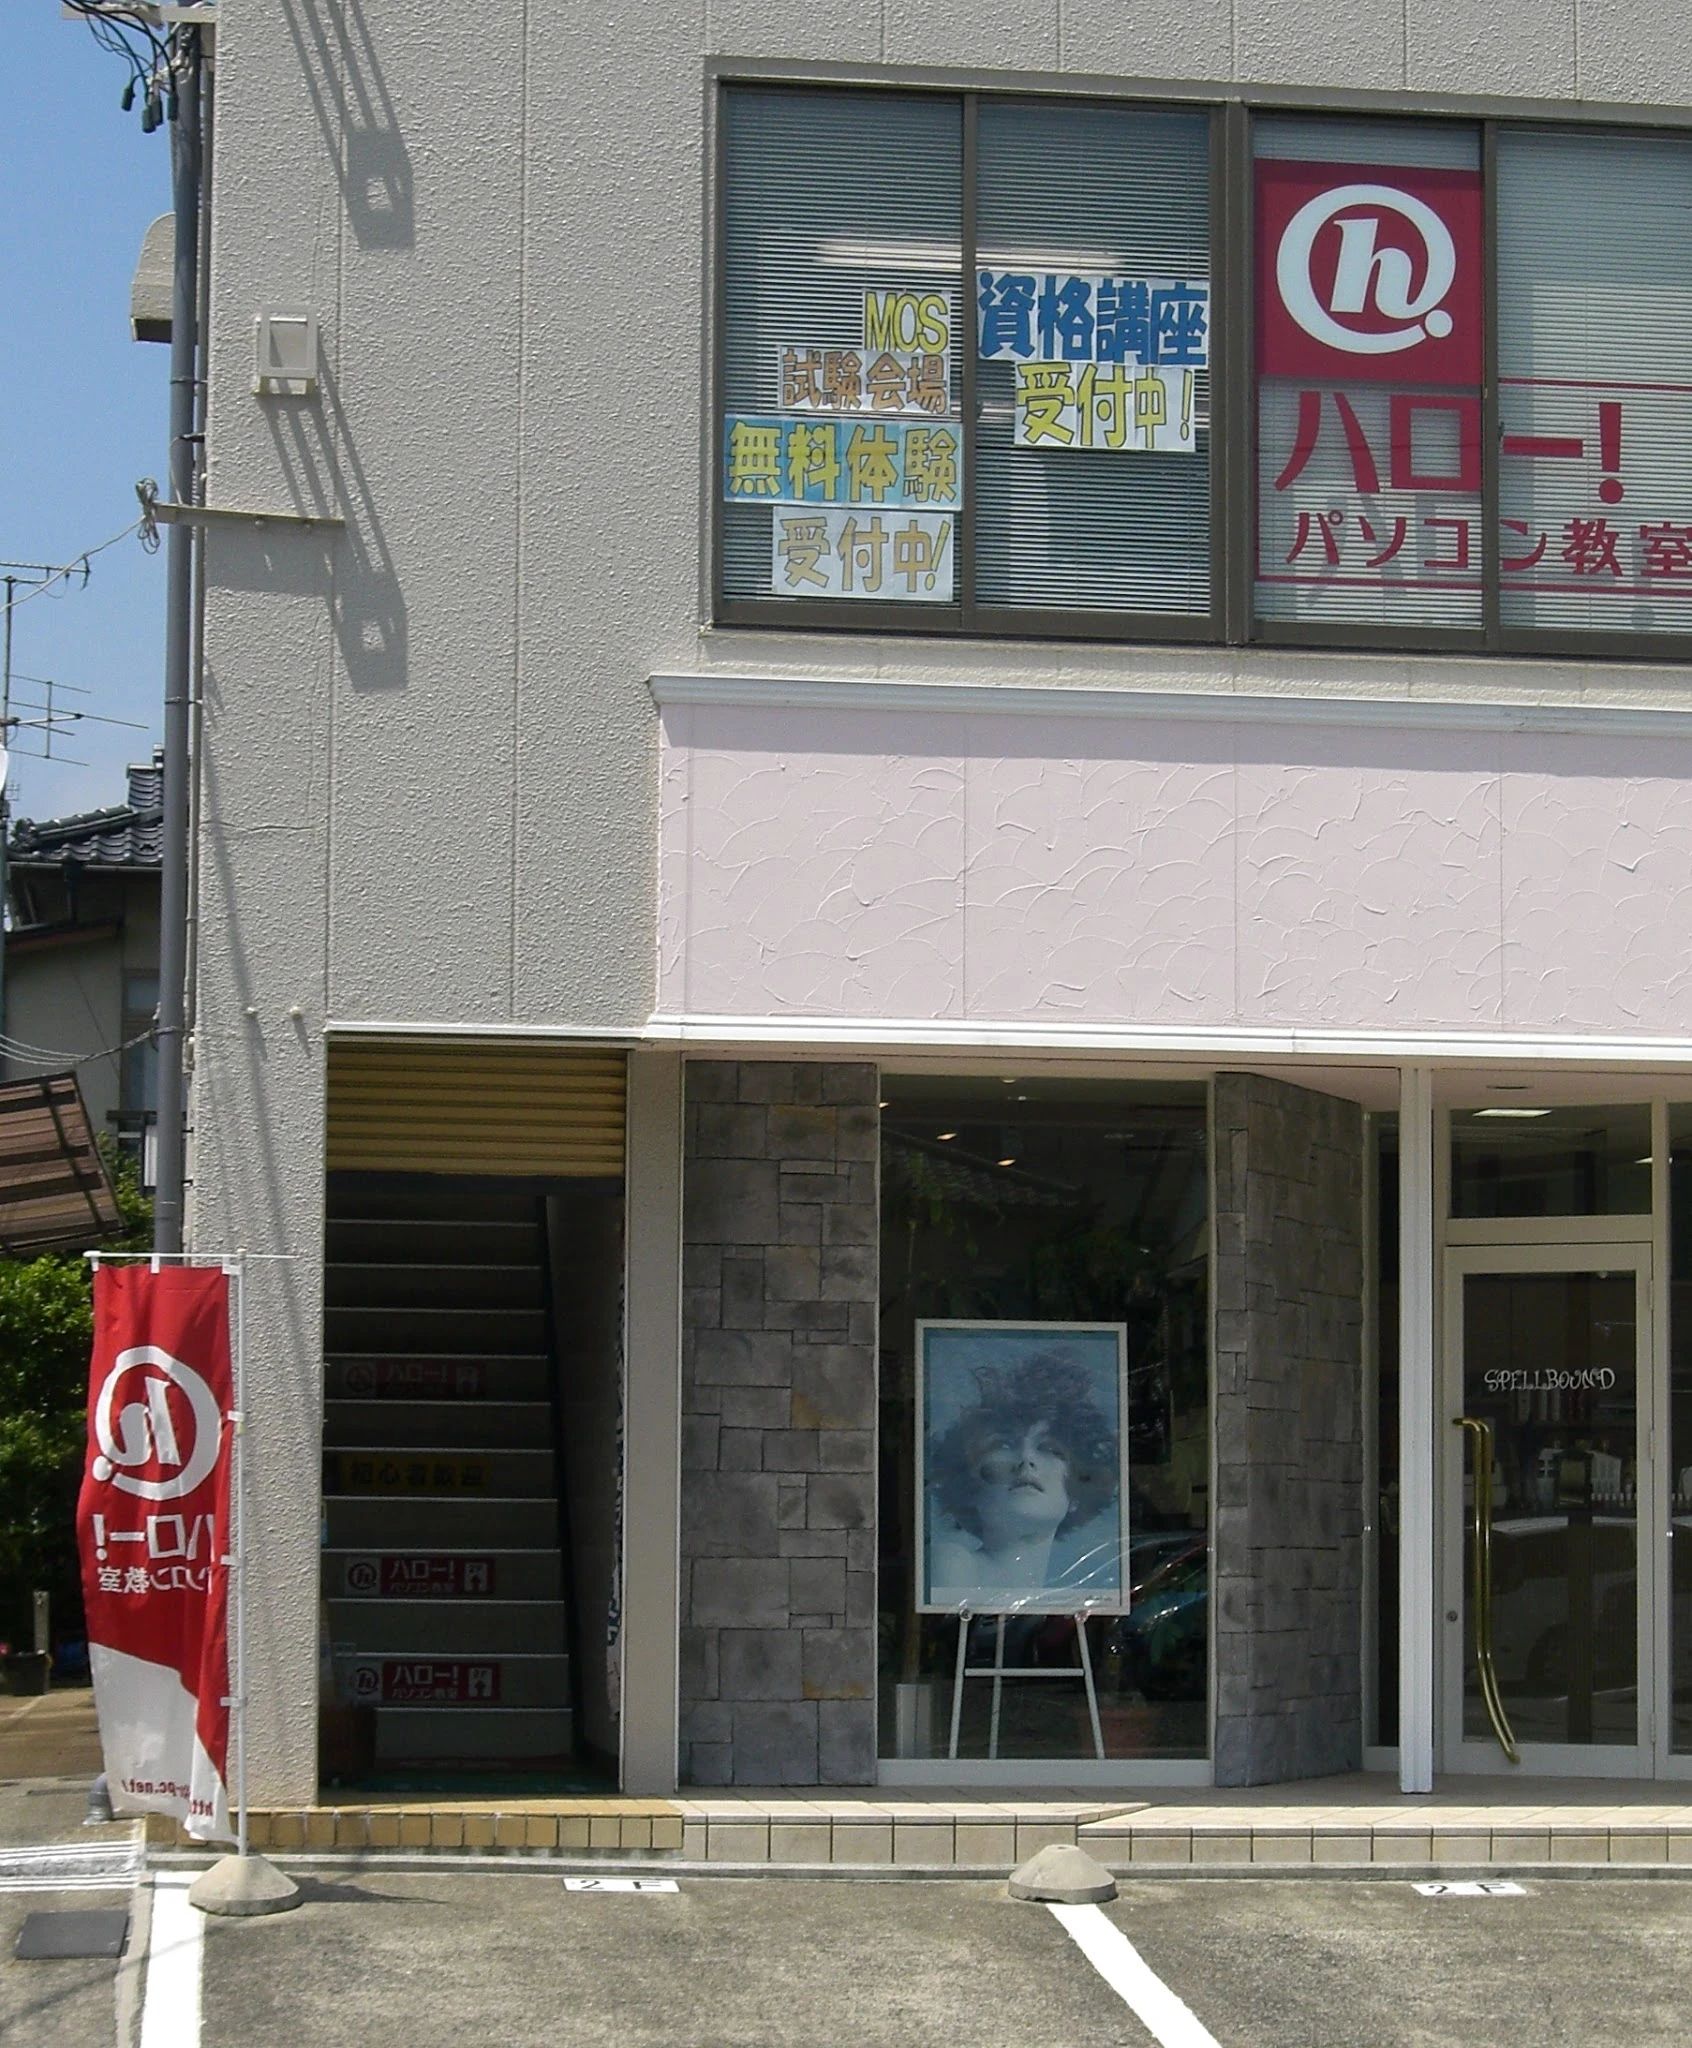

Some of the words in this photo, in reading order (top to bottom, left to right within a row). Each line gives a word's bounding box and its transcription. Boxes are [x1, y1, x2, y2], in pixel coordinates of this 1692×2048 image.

[865, 291, 949, 354] MOS
[979, 271, 1208, 366] 資格講座
[782, 348, 947, 413] 試験会場
[1016, 362, 1194, 449] 受付中!
[728, 420, 959, 503] 無料体験
[1274, 391, 1624, 504] ハロー!
[778, 516, 951, 594] 受付中!
[1286, 511, 1692, 578] パソコン教室
[1484, 1367, 1616, 1392] SPELLBOUND
[388, 1559, 455, 1580] ハロー!
[392, 1665, 460, 1686] ハロー!
